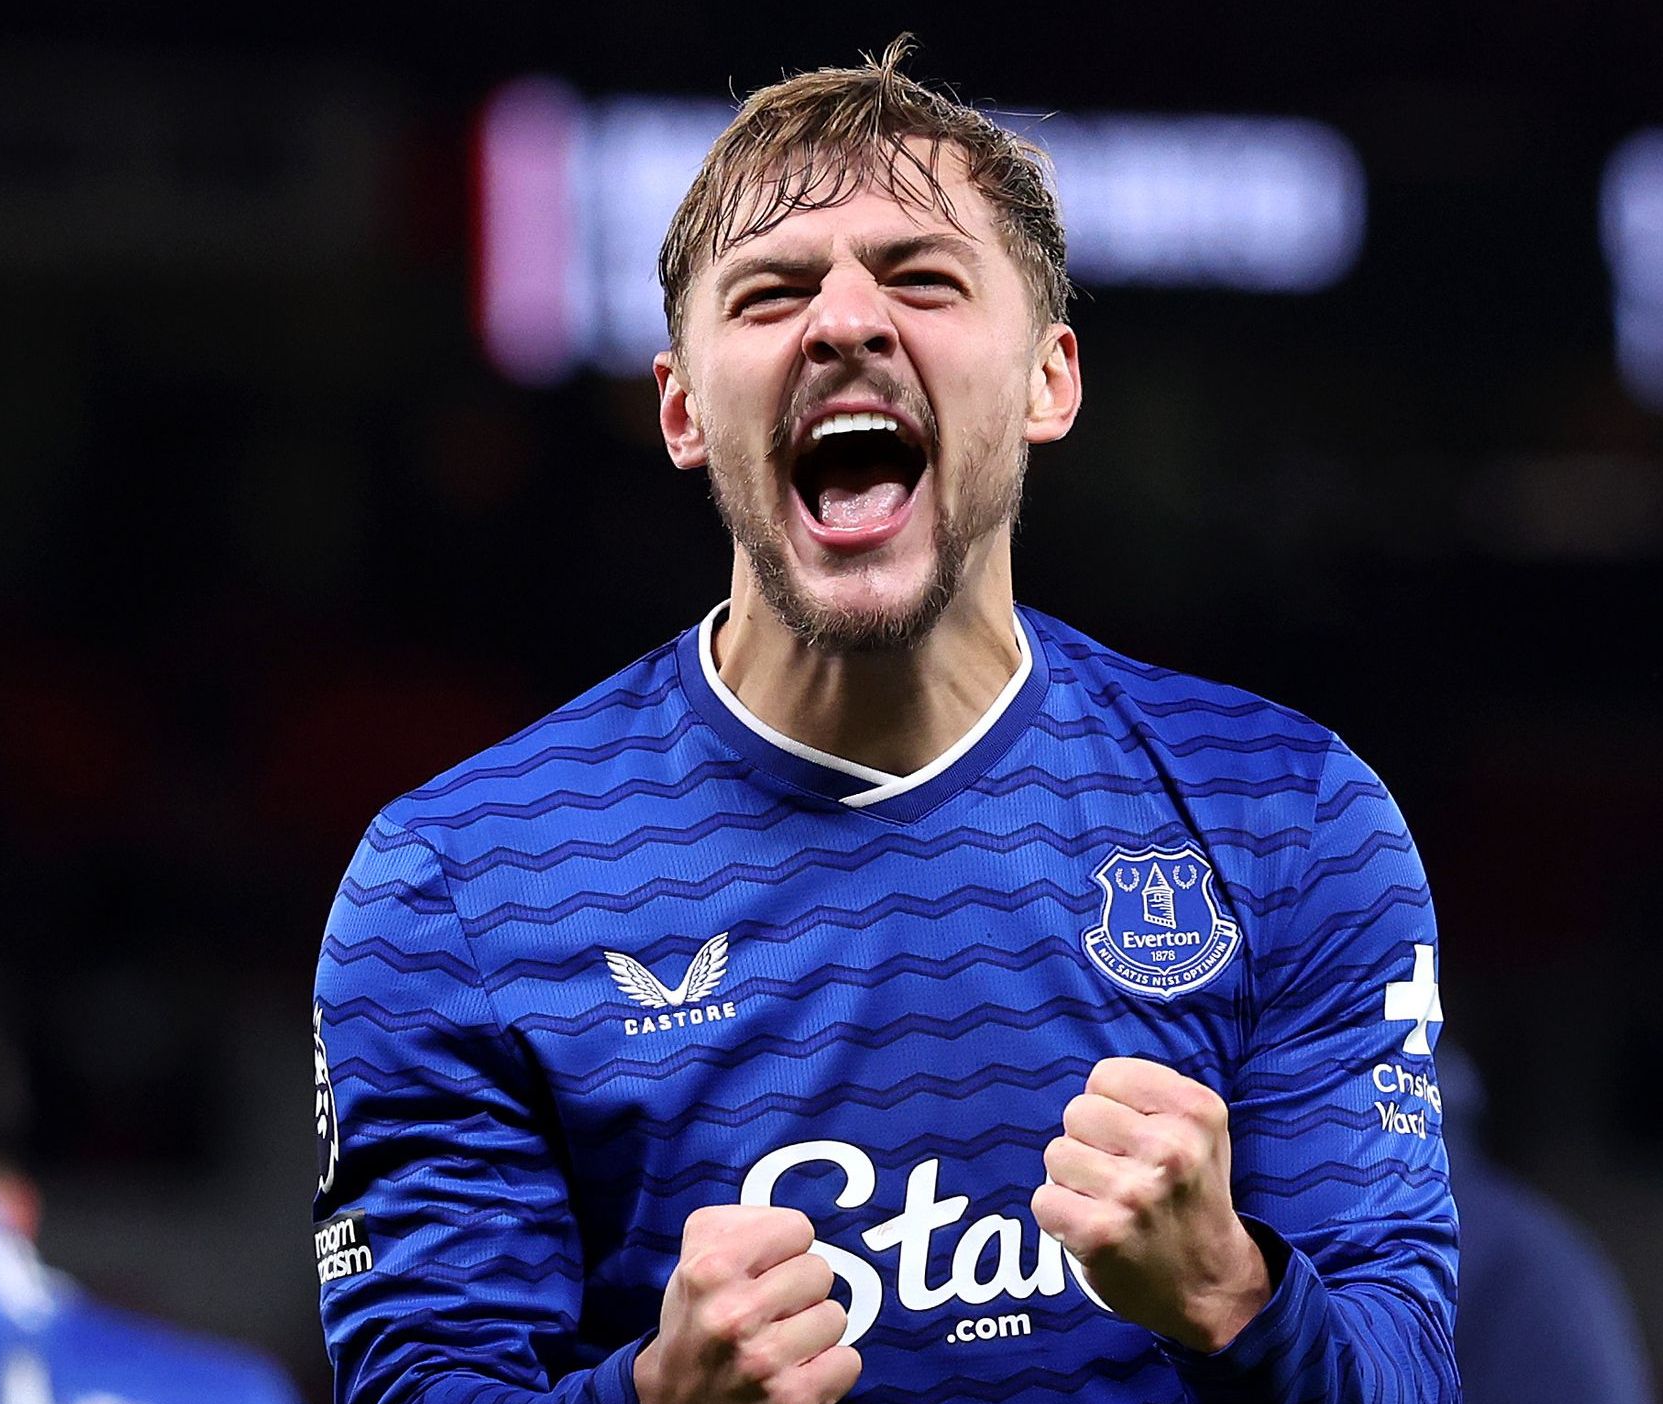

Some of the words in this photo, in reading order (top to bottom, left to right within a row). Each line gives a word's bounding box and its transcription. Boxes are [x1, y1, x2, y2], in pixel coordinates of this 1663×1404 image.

[1122, 931, 1200, 948] Everton
[1151, 950, 1176, 962] 1878
[1098, 947, 1116, 967] NIL
[1116, 964, 1149, 984] SATIS
[1152, 974, 1181, 986] NISI
[624, 1001, 736, 1036] CASTORE
[1374, 1101, 1427, 1140] Ward
[314, 1218, 355, 1259] room
[740, 1140, 1114, 1348] Sta
[947, 1313, 1031, 1344] .com
